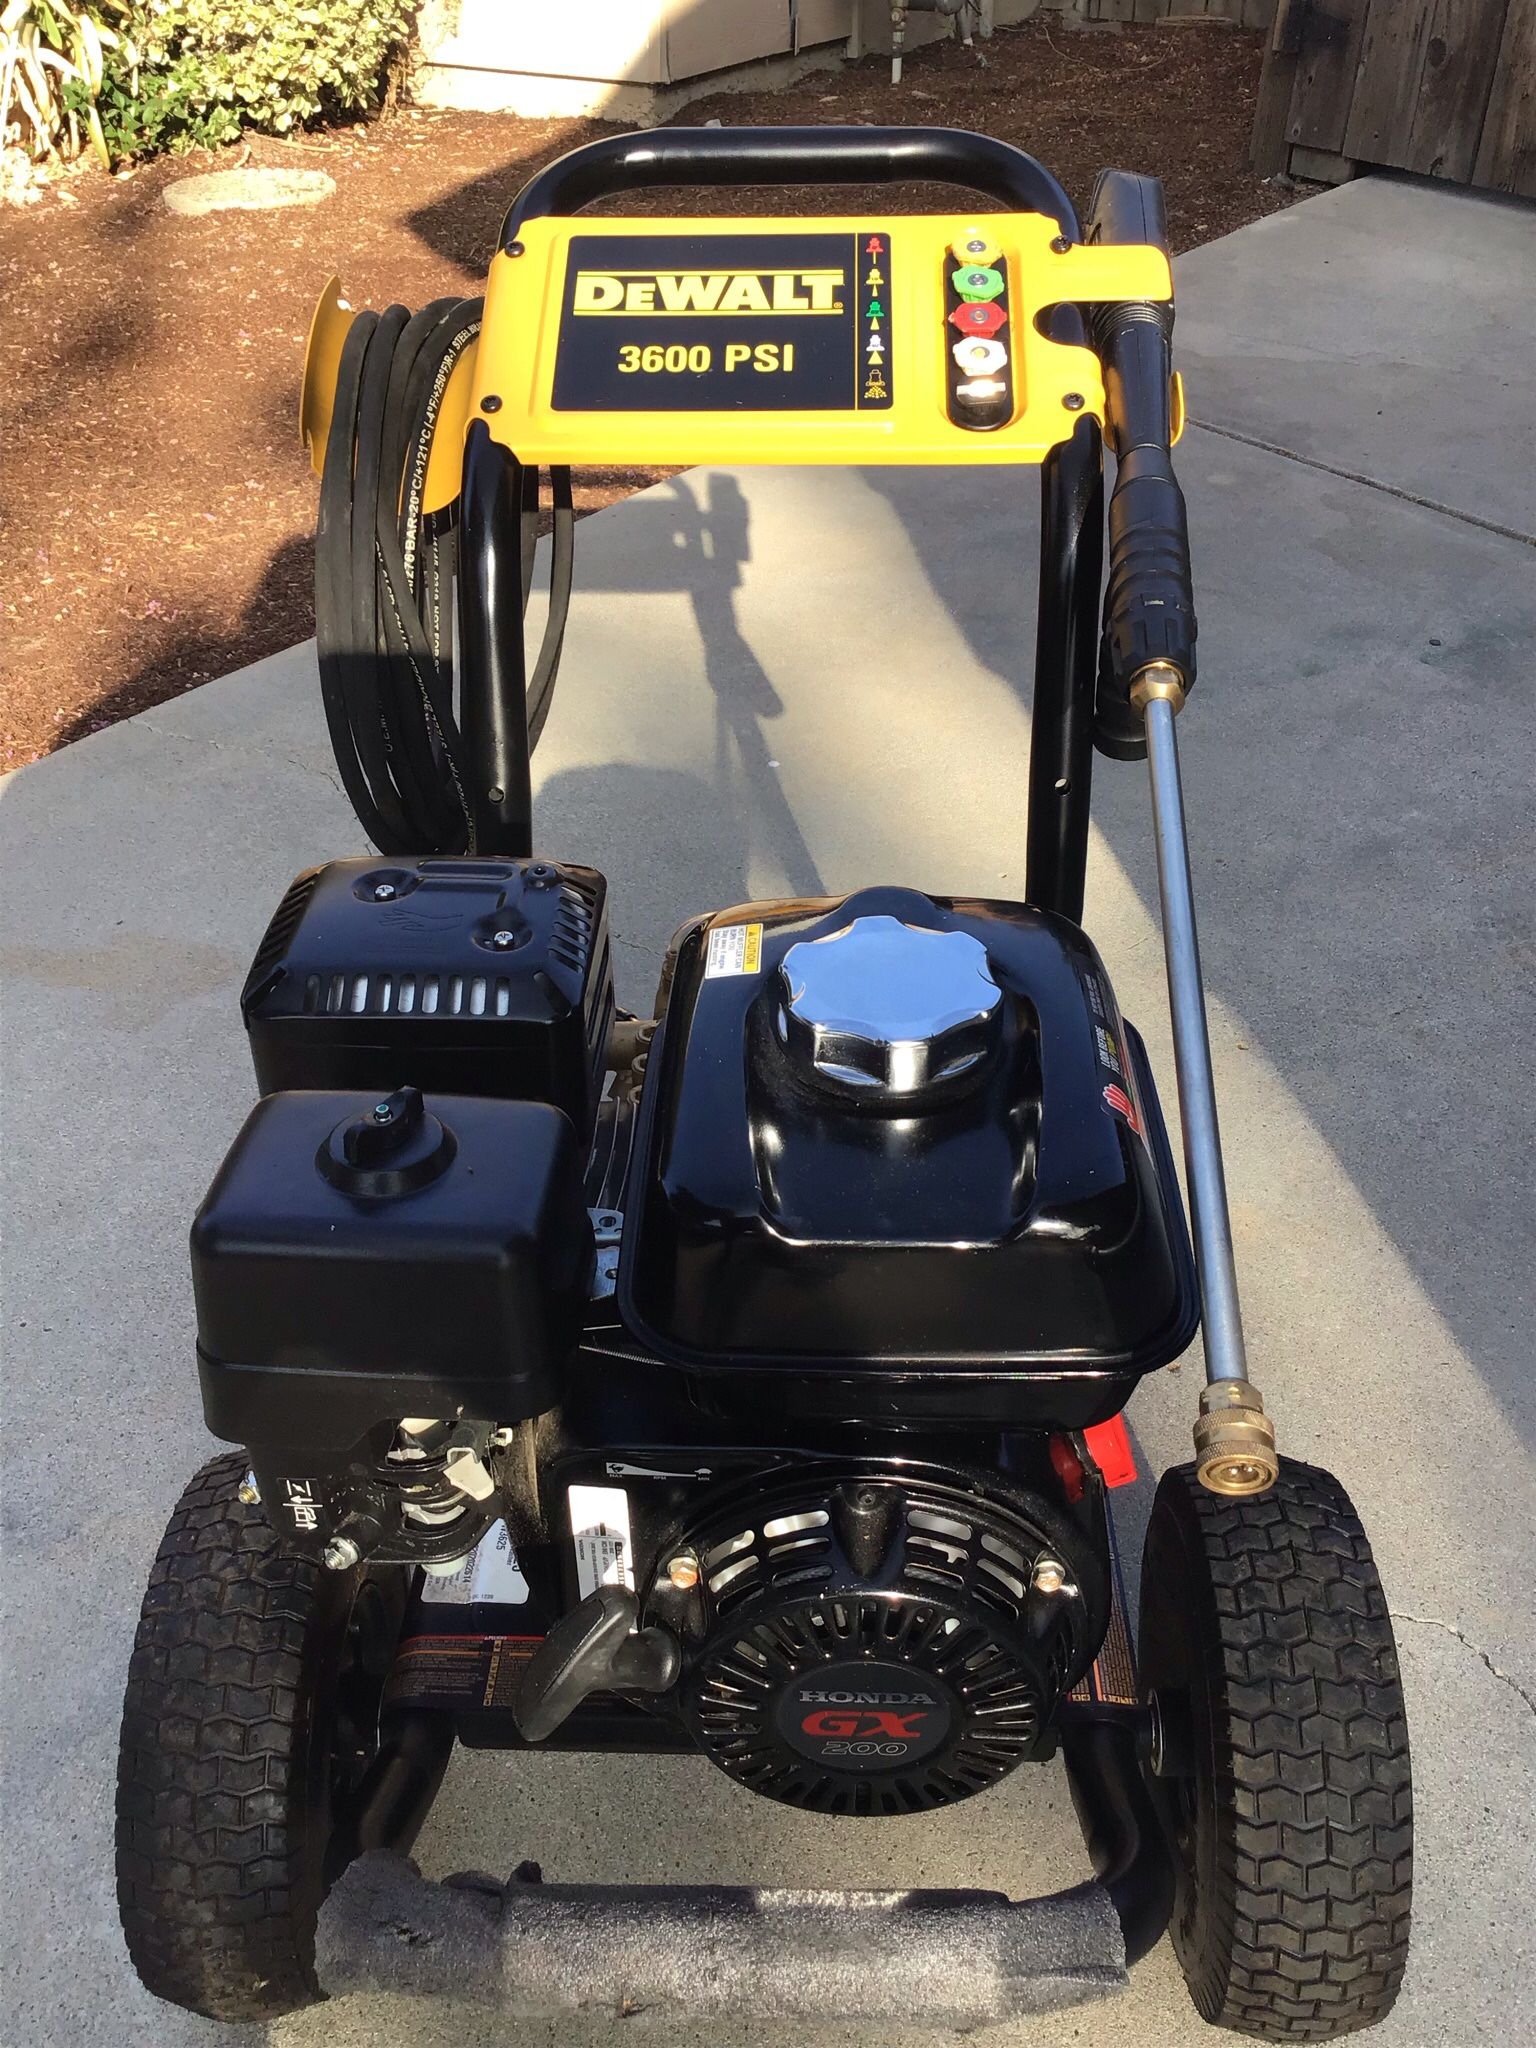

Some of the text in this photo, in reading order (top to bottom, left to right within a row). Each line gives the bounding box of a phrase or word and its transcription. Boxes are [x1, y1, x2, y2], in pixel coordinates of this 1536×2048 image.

[617, 344, 794, 373] 3600 PSI
[746, 937, 757, 965] CAUTION
[799, 1690, 937, 1704] HONDA
[801, 1710, 929, 1738] GX
[821, 1741, 908, 1756] 200
